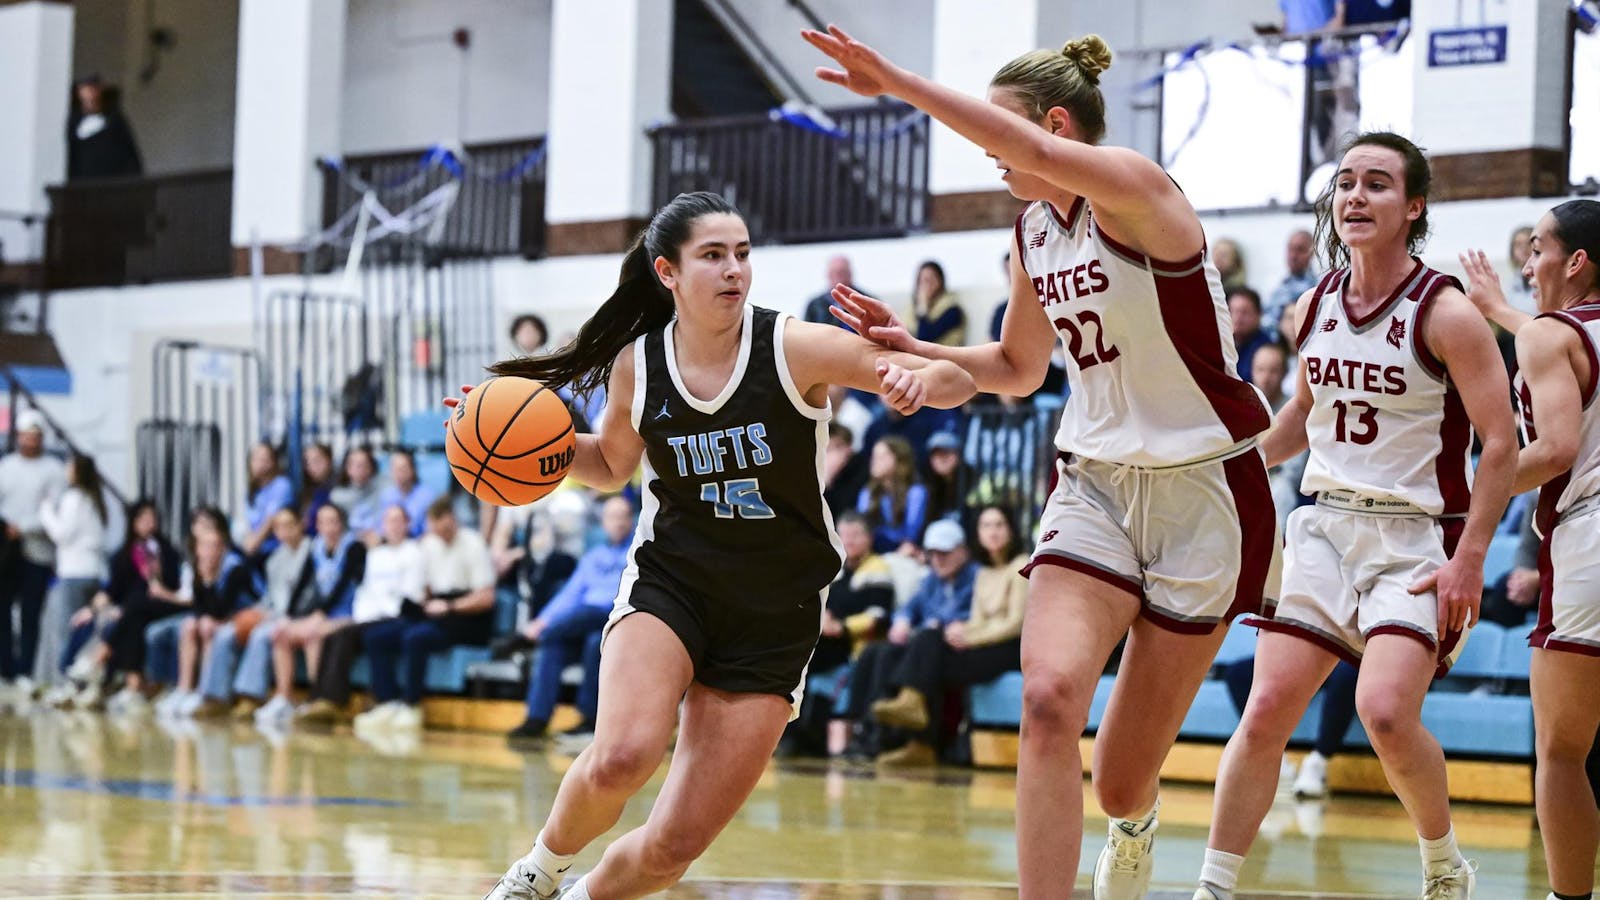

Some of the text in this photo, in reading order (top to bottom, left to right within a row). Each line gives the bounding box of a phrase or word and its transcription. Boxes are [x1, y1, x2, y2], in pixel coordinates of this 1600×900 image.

[1032, 259, 1109, 308] BATES
[1053, 310, 1121, 371] 22
[1307, 357, 1407, 396] BATES
[1332, 399, 1379, 445] 13
[667, 422, 773, 477] TUFTS
